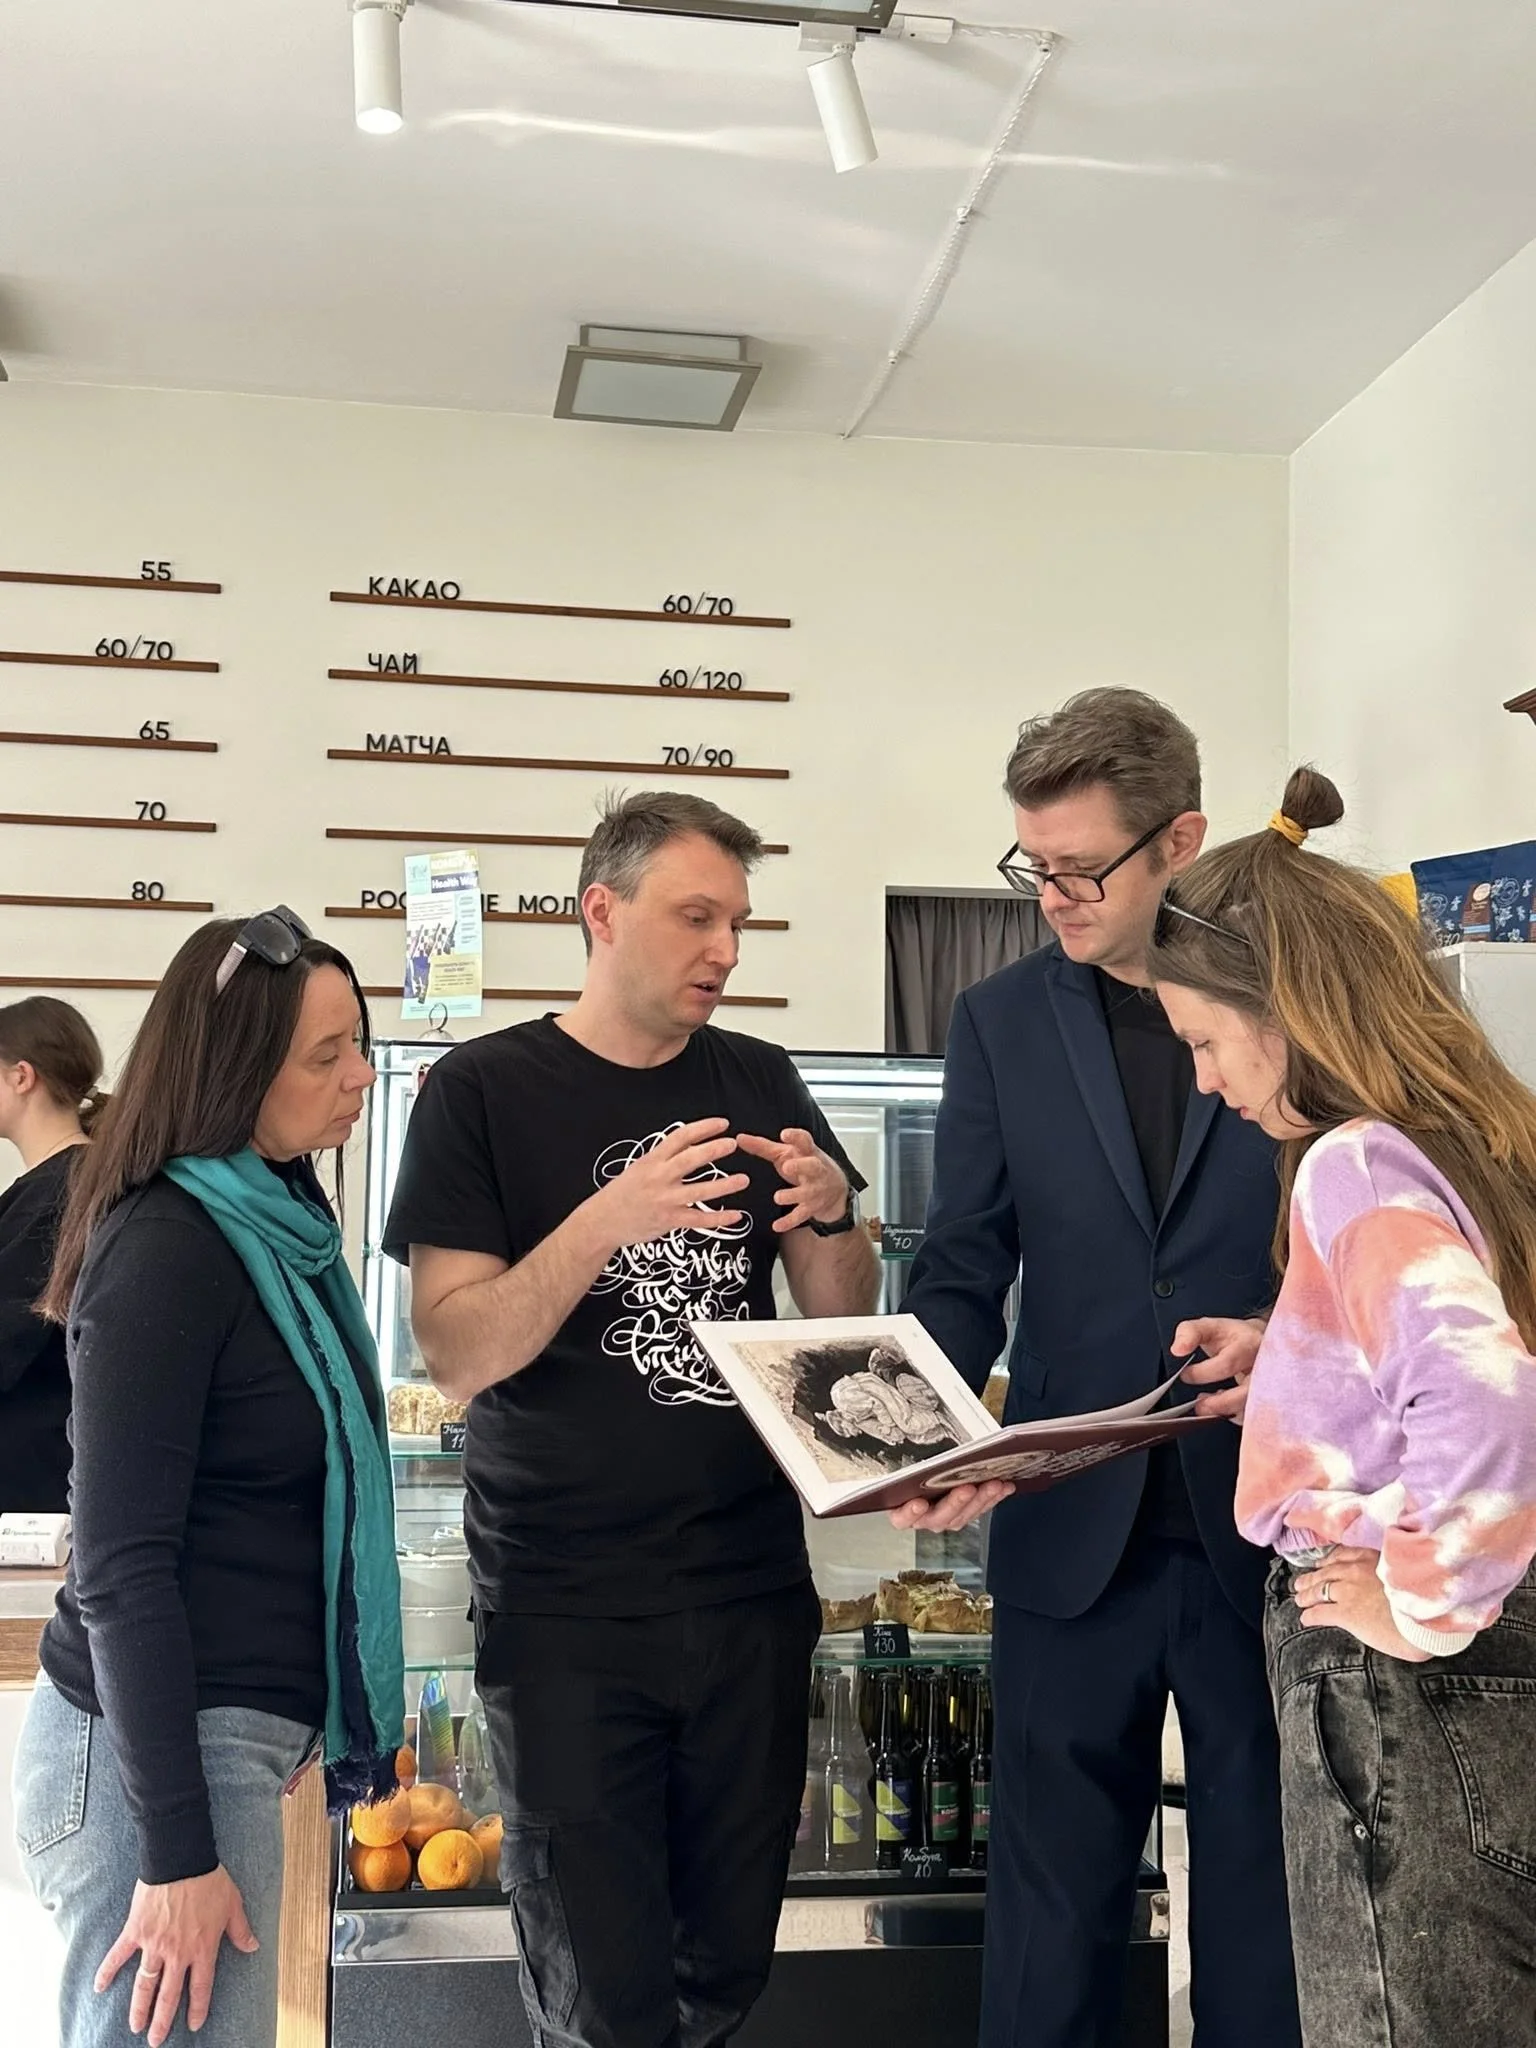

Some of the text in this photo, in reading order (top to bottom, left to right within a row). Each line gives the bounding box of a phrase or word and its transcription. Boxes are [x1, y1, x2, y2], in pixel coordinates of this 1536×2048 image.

[140, 561, 172, 582] 55
[368, 577, 733, 616] КАКАО 60/70
[94, 634, 173, 661] 60/70
[367, 652, 742, 691] ЧАЙ 60/120
[139, 721, 170, 741] 65
[366, 734, 733, 768] МАТЧА 70/90
[135, 801, 166, 822] 70
[131, 881, 164, 902] 80
[432, 877, 459, 889] Health
[519, 895, 576, 914] МОЛ
[893, 1237, 912, 1249] 70
[451, 1434, 466, 1449] 11
[874, 1637, 896, 1654] 130
